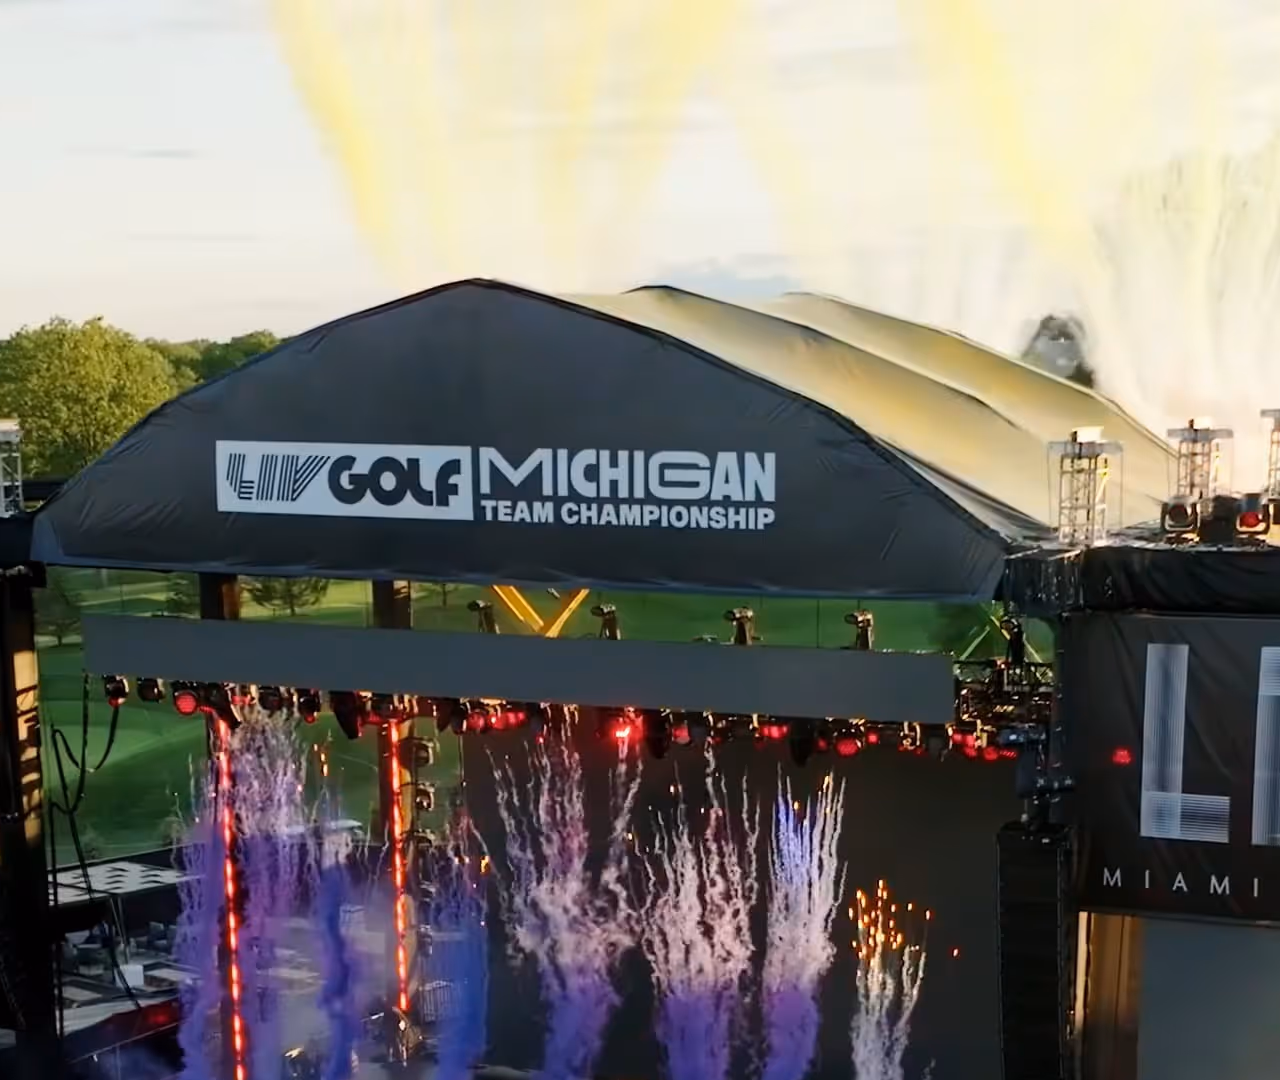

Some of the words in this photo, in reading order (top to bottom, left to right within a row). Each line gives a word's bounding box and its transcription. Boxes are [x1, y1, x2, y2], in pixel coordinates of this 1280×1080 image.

[224, 452, 332, 502] LIV
[328, 454, 462, 507] GOLF
[478, 446, 776, 502] MICHIGAN
[480, 501, 554, 524] TEAM
[561, 503, 776, 531] CHAMPIONSHIP
[1103, 867, 1259, 898] MIAMI
